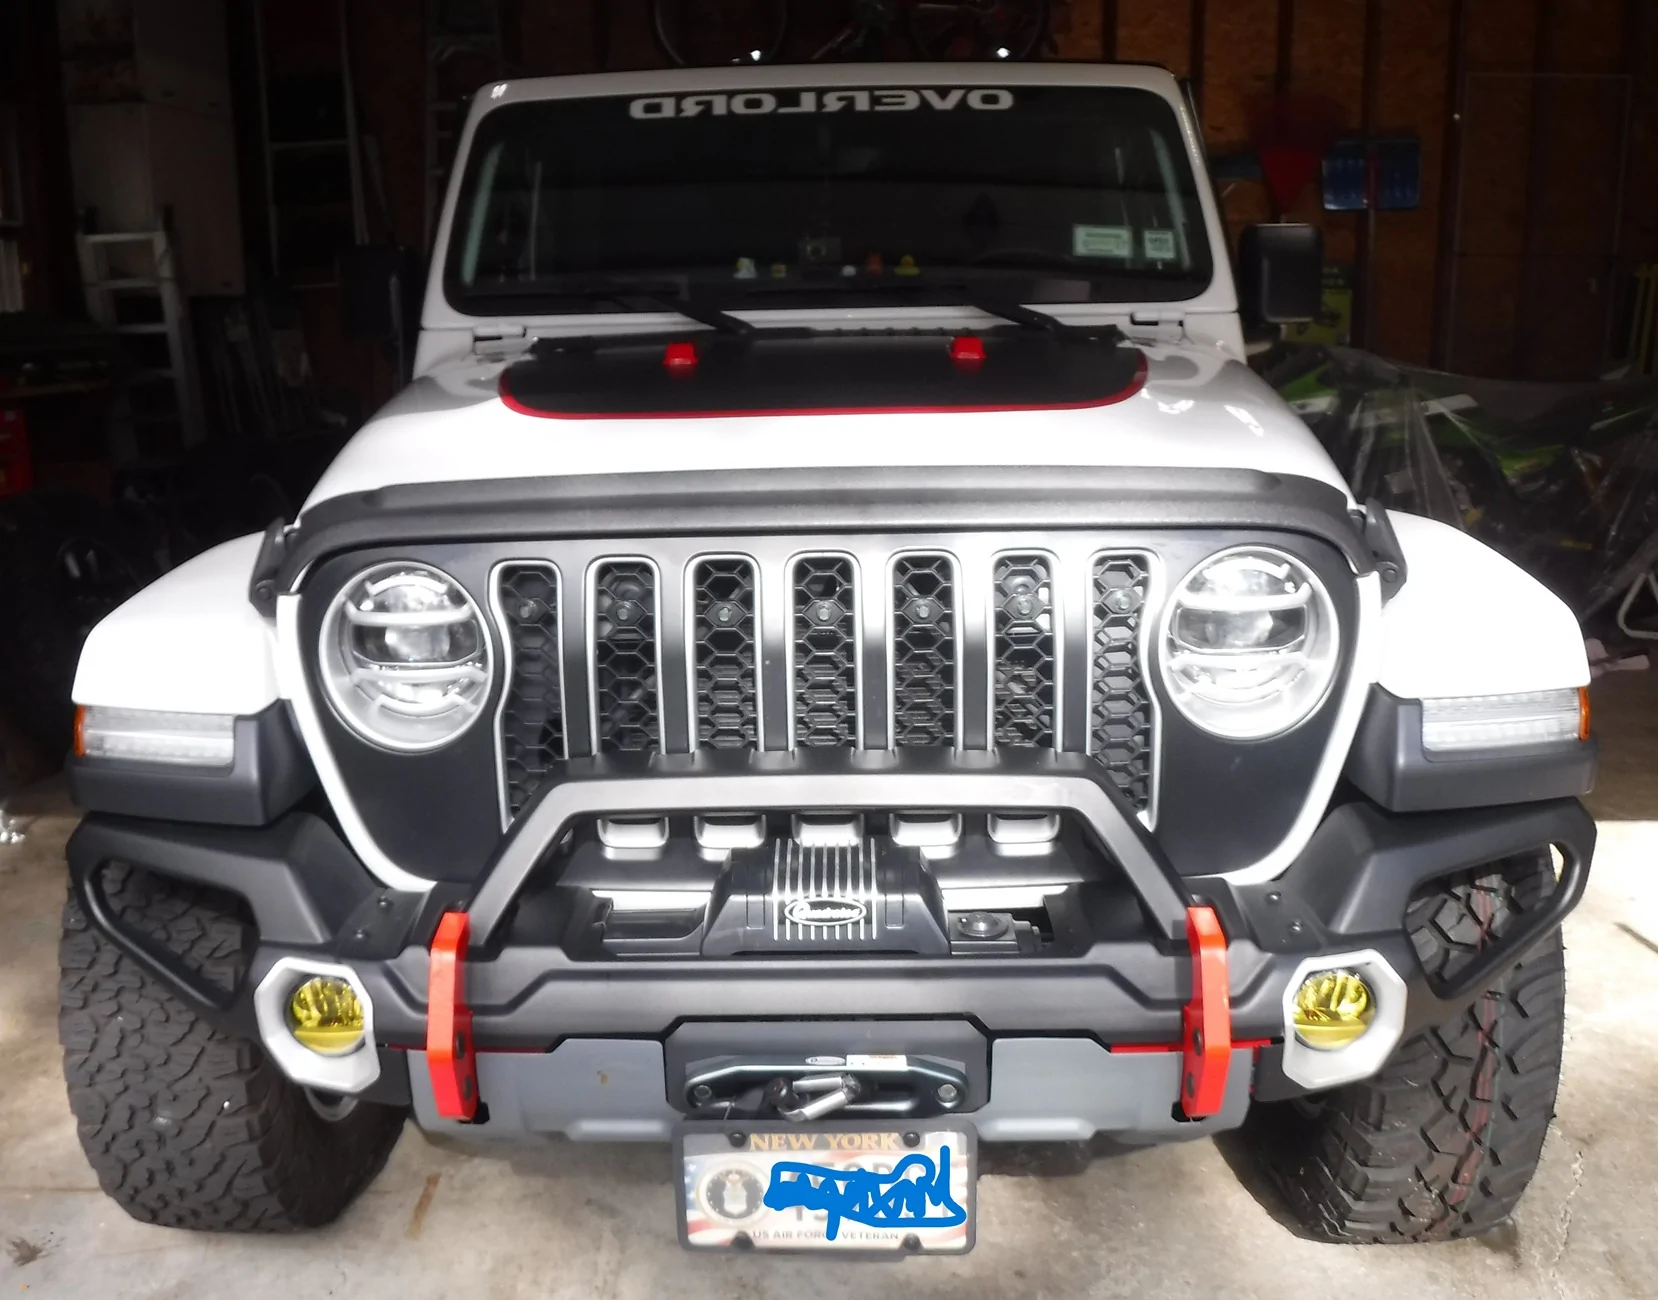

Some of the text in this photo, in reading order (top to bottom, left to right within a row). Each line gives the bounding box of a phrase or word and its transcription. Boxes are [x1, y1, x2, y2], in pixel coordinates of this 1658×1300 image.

[750, 1132, 900, 1151] NEW YORK
[752, 1229, 899, 1241] US AIR FORC VETERAN
